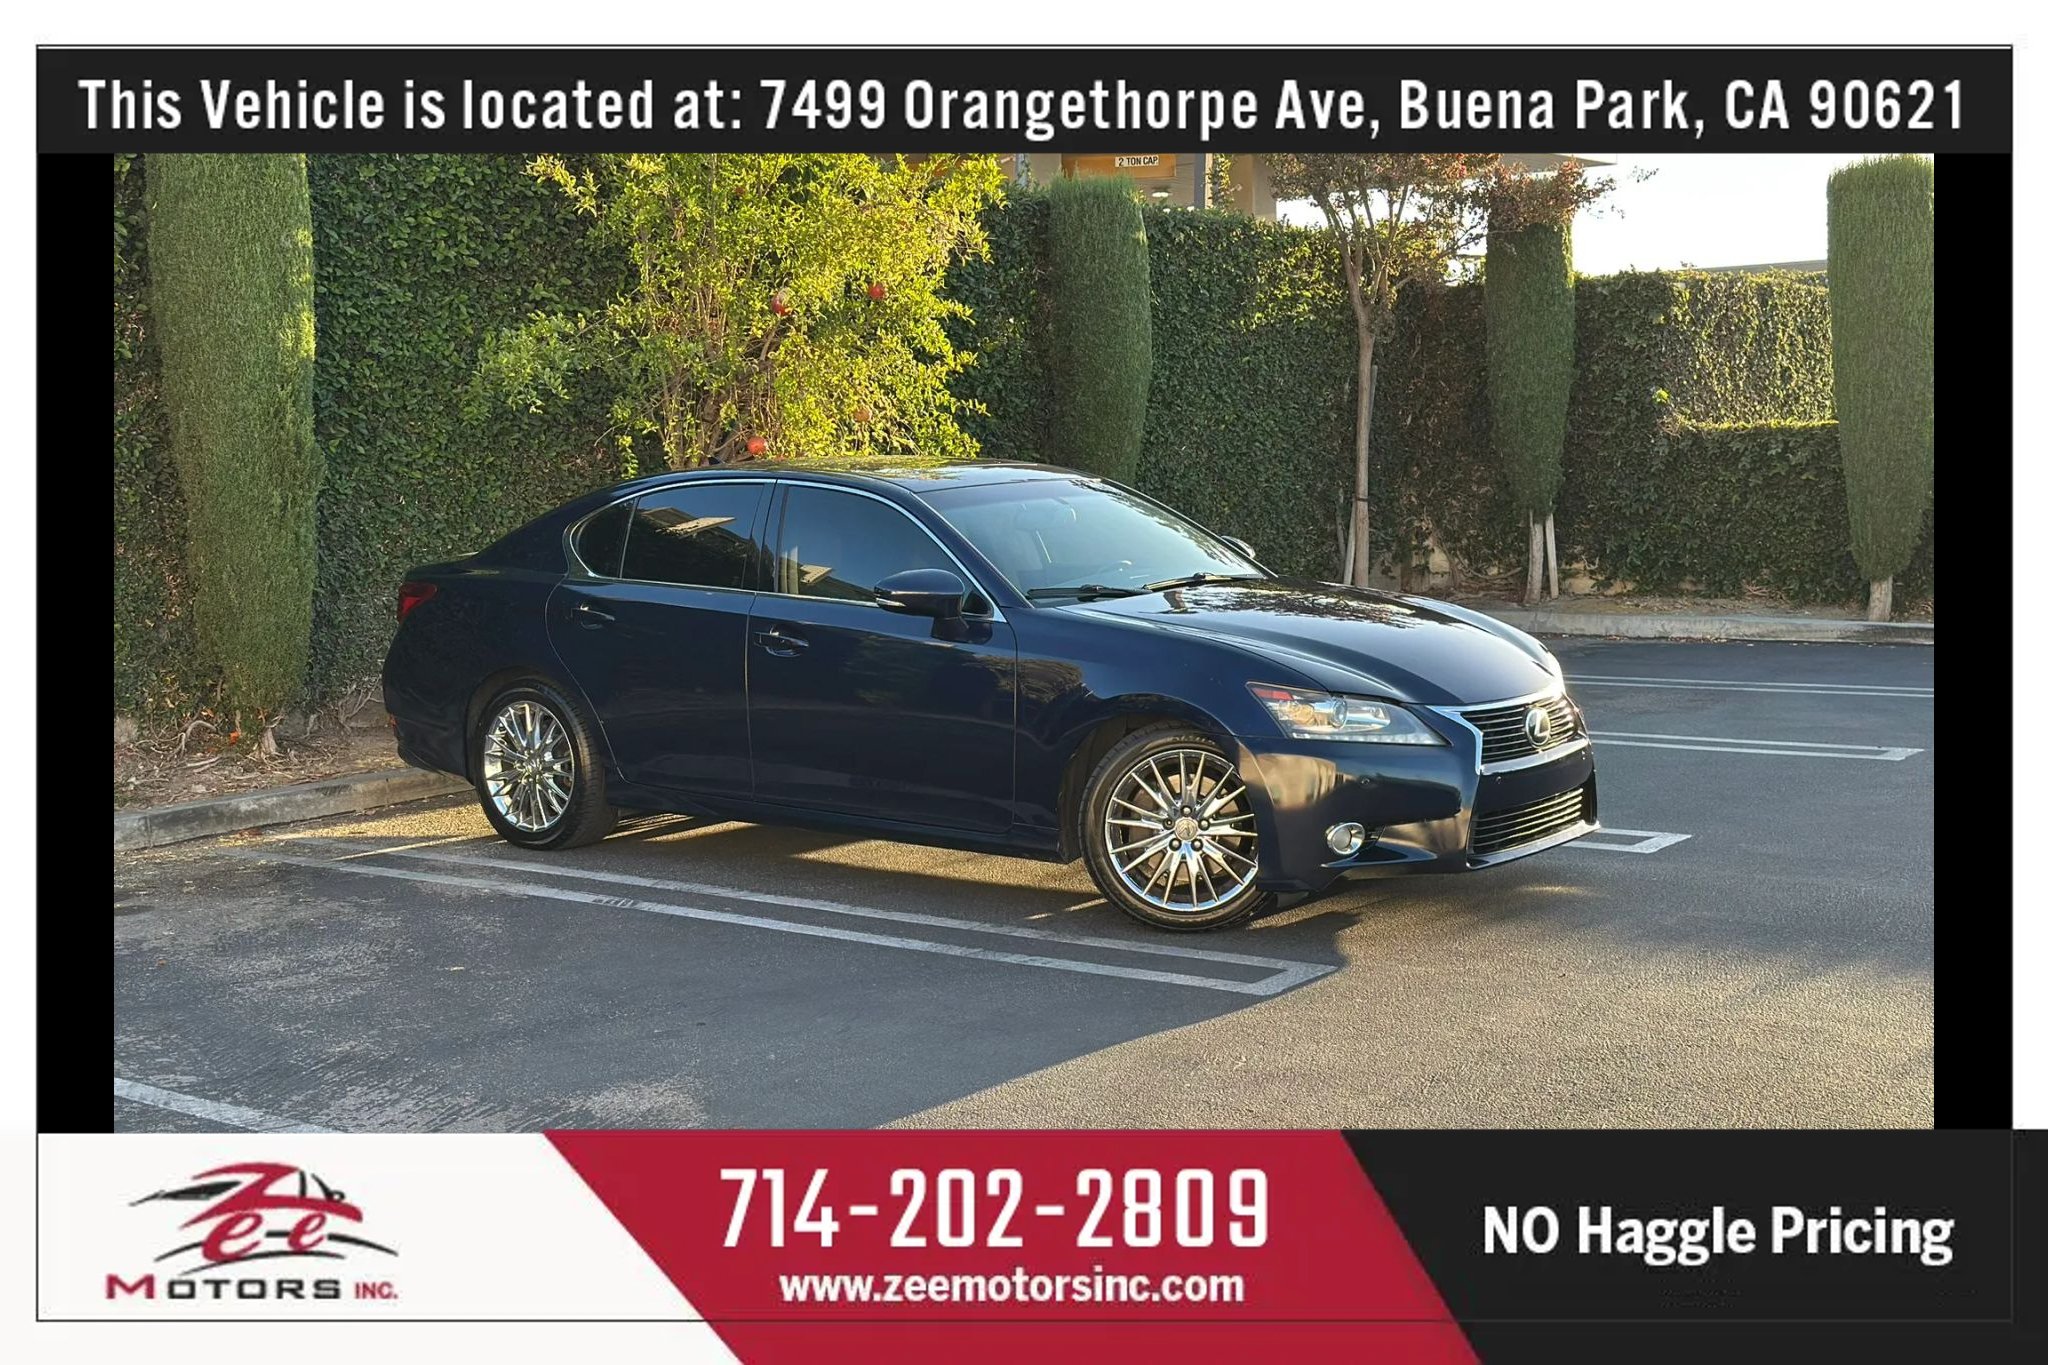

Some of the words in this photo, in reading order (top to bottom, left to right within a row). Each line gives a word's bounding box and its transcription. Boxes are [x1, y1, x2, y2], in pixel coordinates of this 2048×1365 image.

[1118, 157, 1124, 167] 2
[1126, 157, 1142, 166] TON
[1142, 156, 1158, 166] CAP
